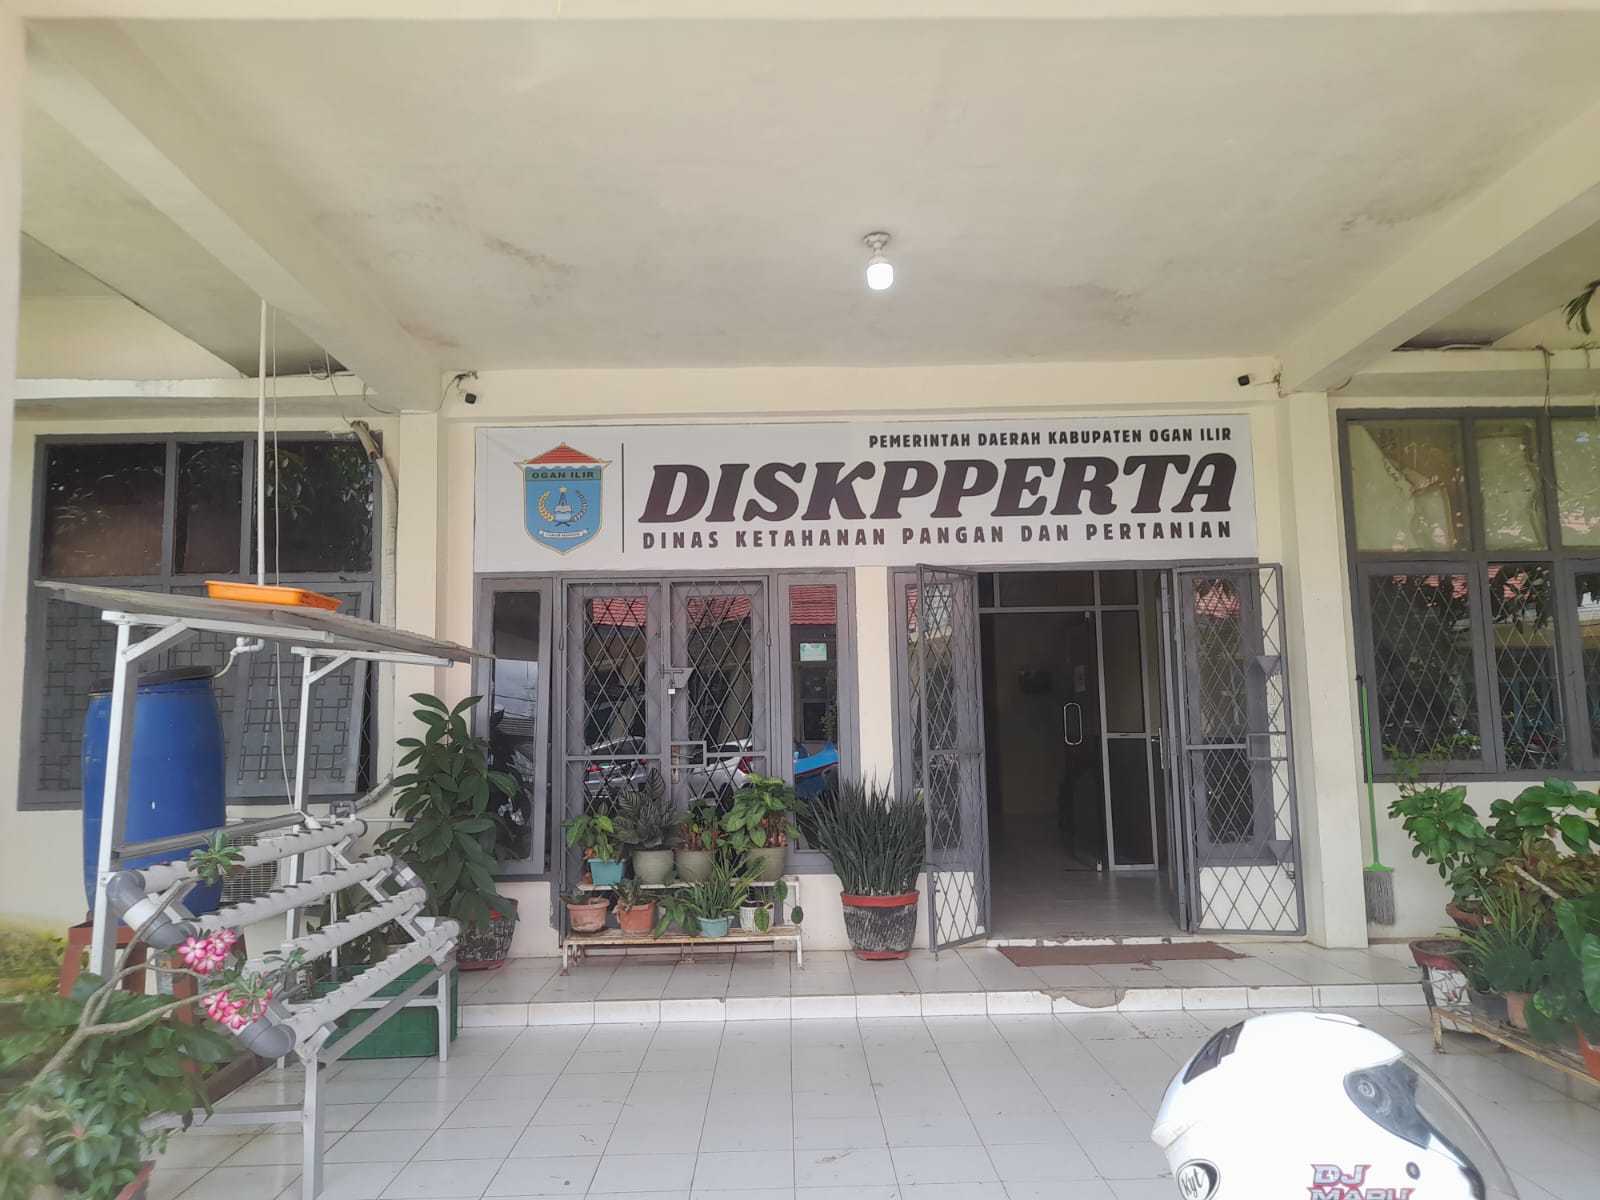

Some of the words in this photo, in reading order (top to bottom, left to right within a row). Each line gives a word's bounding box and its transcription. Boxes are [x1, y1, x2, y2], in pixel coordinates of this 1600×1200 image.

[869, 433, 971, 449] PEMERINTAH
[977, 431, 1041, 447] DAERAH
[1048, 429, 1142, 446] KABUPATEN
[1149, 428, 1193, 443] OGAN
[1199, 427, 1232, 442] ILIR
[531, 471, 567, 480] OGAN
[570, 471, 594, 479] ILIR
[637, 452, 1237, 524] DISKPPERTA
[643, 531, 719, 550] DINAS
[735, 528, 885, 549] KETAHANAN
[902, 527, 1003, 545] PANGAN
[1021, 525, 1068, 542] DAN
[1086, 520, 1231, 541] PERTANIAN
[1310, 1164, 1371, 1187] DJ
